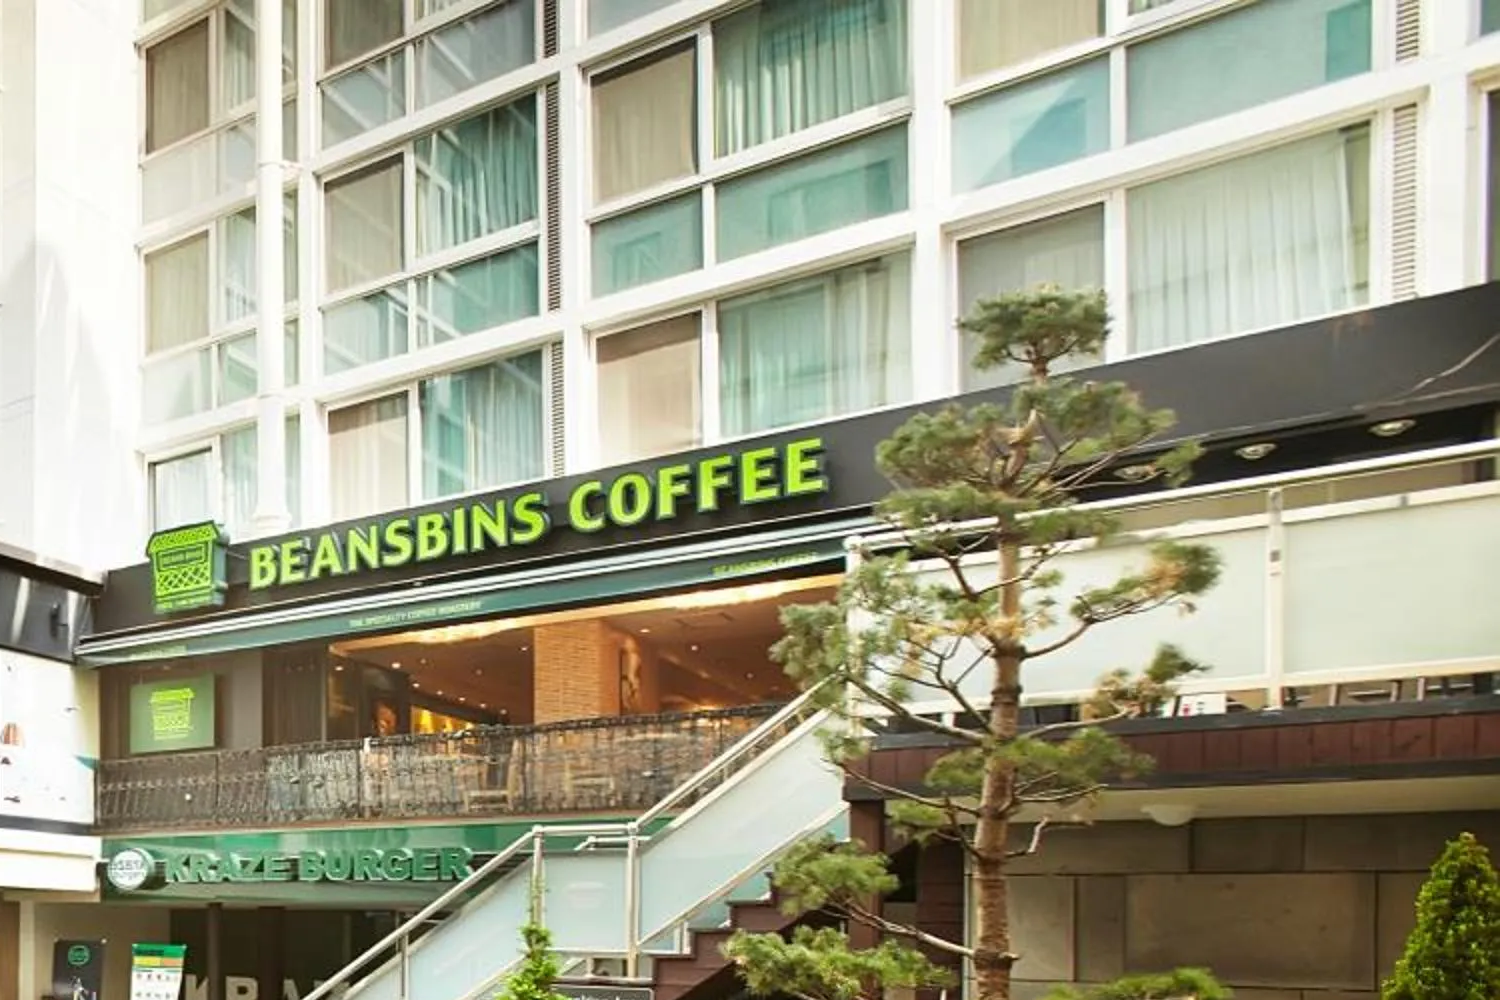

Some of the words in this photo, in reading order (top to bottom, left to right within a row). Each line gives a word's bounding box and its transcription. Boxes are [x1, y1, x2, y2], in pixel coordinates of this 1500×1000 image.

[250, 491, 548, 590] BEANSBINS
[569, 438, 826, 531] COFFEE
[164, 849, 290, 882] KRAZE
[299, 846, 472, 882] BURGER
